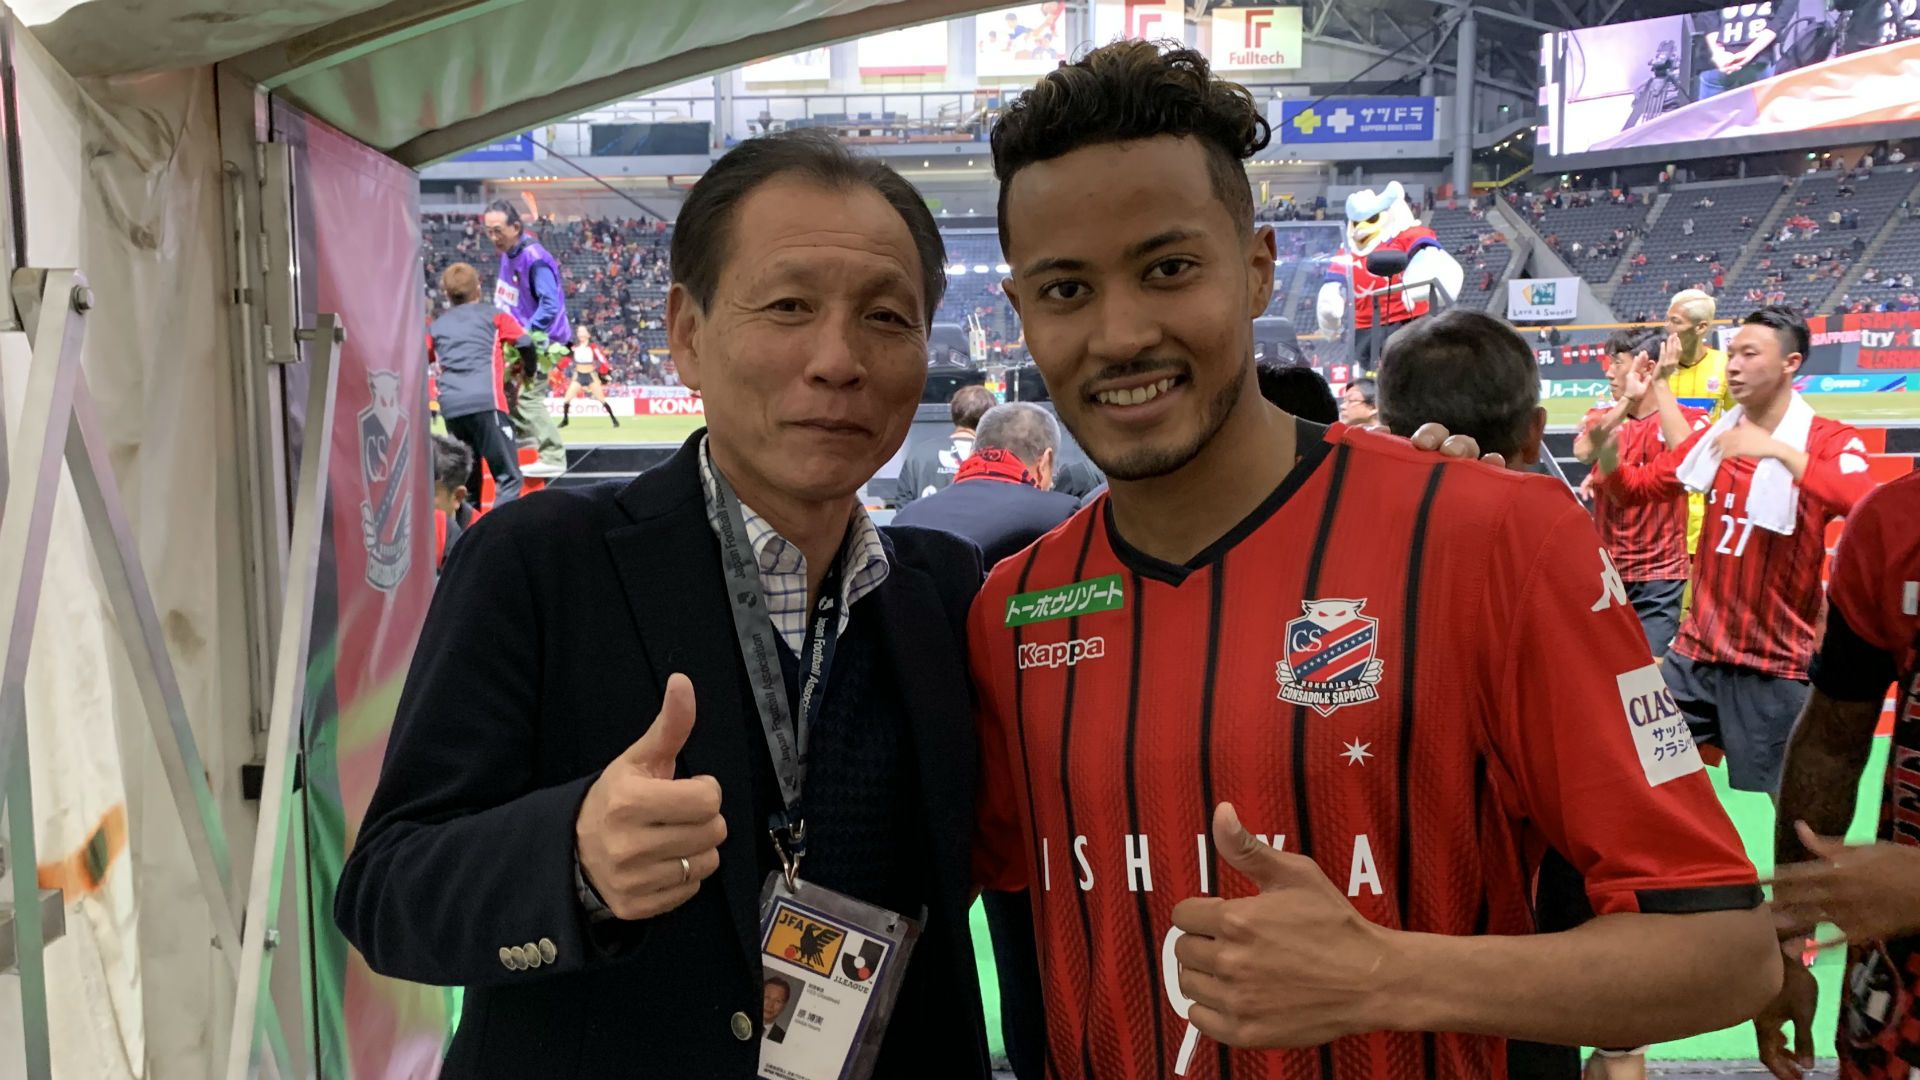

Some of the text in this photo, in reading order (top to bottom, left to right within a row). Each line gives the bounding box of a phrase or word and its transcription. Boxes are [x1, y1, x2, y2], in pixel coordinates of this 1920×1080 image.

[1229, 51, 1285, 65] Fulltech
[1360, 106, 1424, 123] サツドラ
[1861, 329, 1895, 348] try
[649, 399, 706, 414] KONA
[1715, 514, 1754, 557] 27
[1005, 581, 1123, 623] トーホウリゾート
[752, 632, 775, 690] Association
[810, 638, 826, 677] Football
[1018, 636, 1105, 669] Kappa
[764, 691, 782, 732] Football
[1281, 685, 1374, 704] CONSADOLE SAPPORO
[1629, 686, 1681, 727] CLAS
[1043, 834, 1383, 897] ISHIA
[779, 912, 805, 933] JFA
